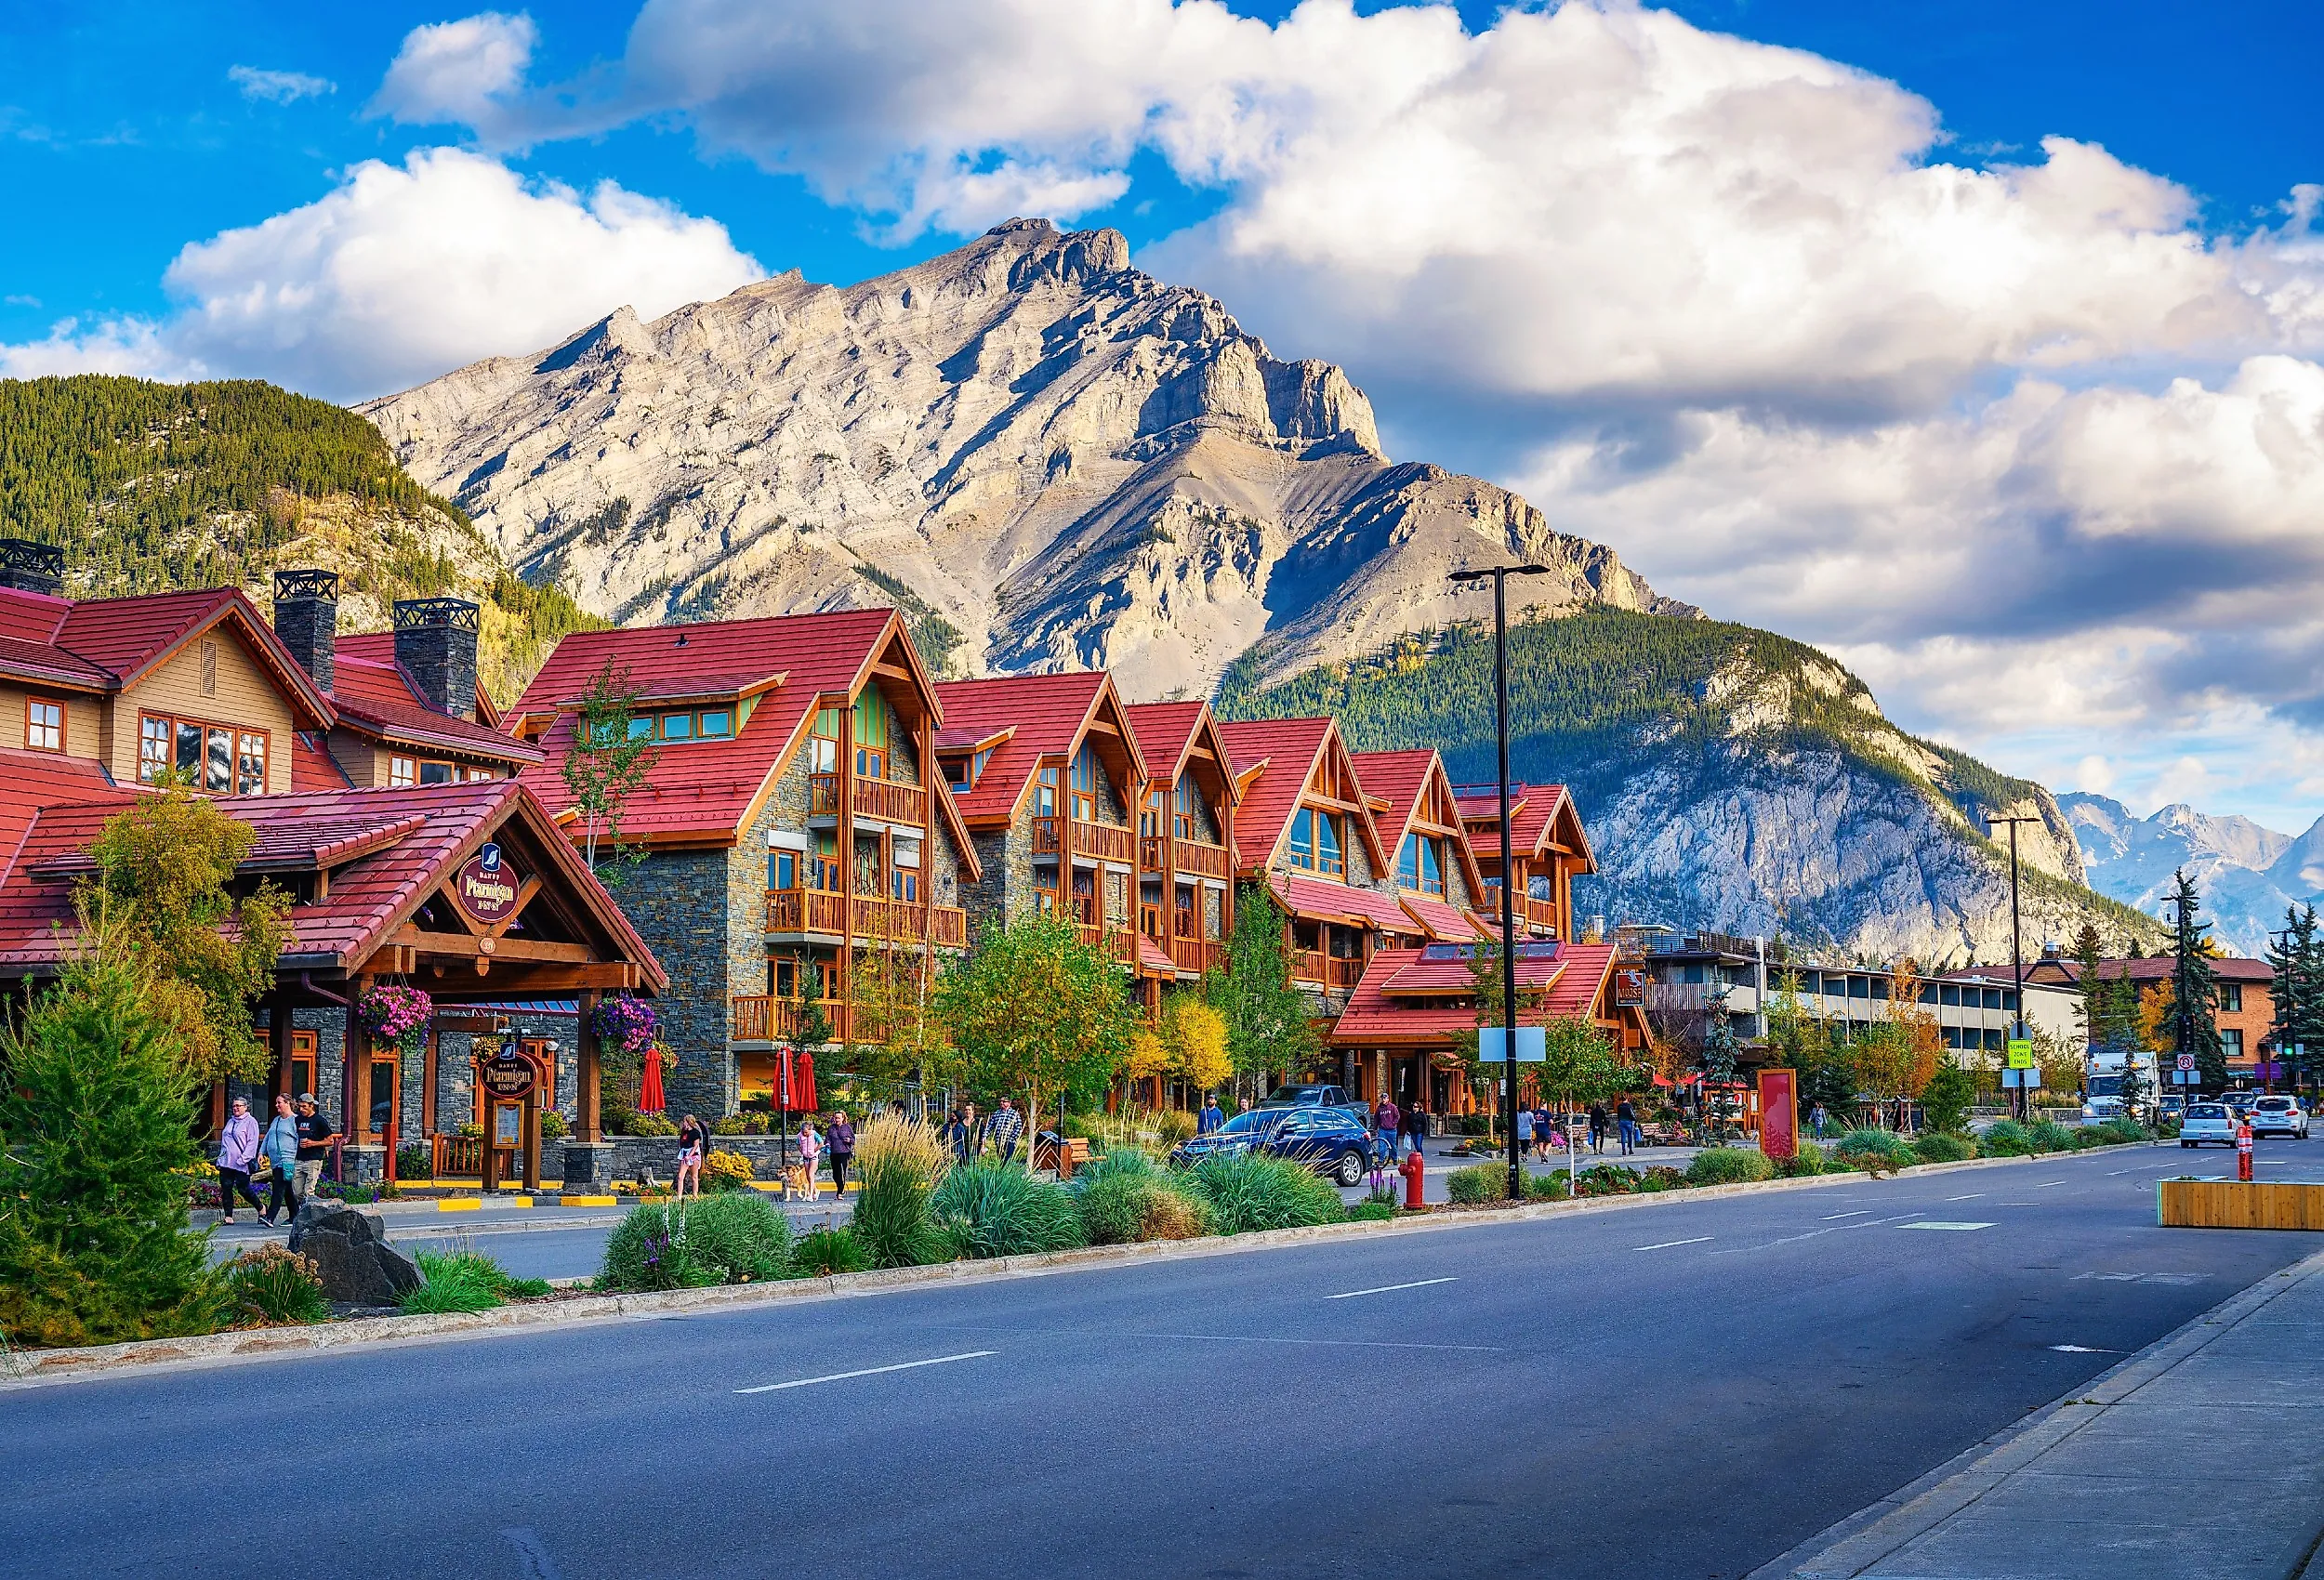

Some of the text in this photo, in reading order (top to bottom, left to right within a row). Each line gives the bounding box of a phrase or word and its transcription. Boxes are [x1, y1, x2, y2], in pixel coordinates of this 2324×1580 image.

[466, 875, 513, 905] Ptarmigan
[1618, 988, 1642, 998] MOOSE
[486, 1066, 532, 1086] Ptarmigan
